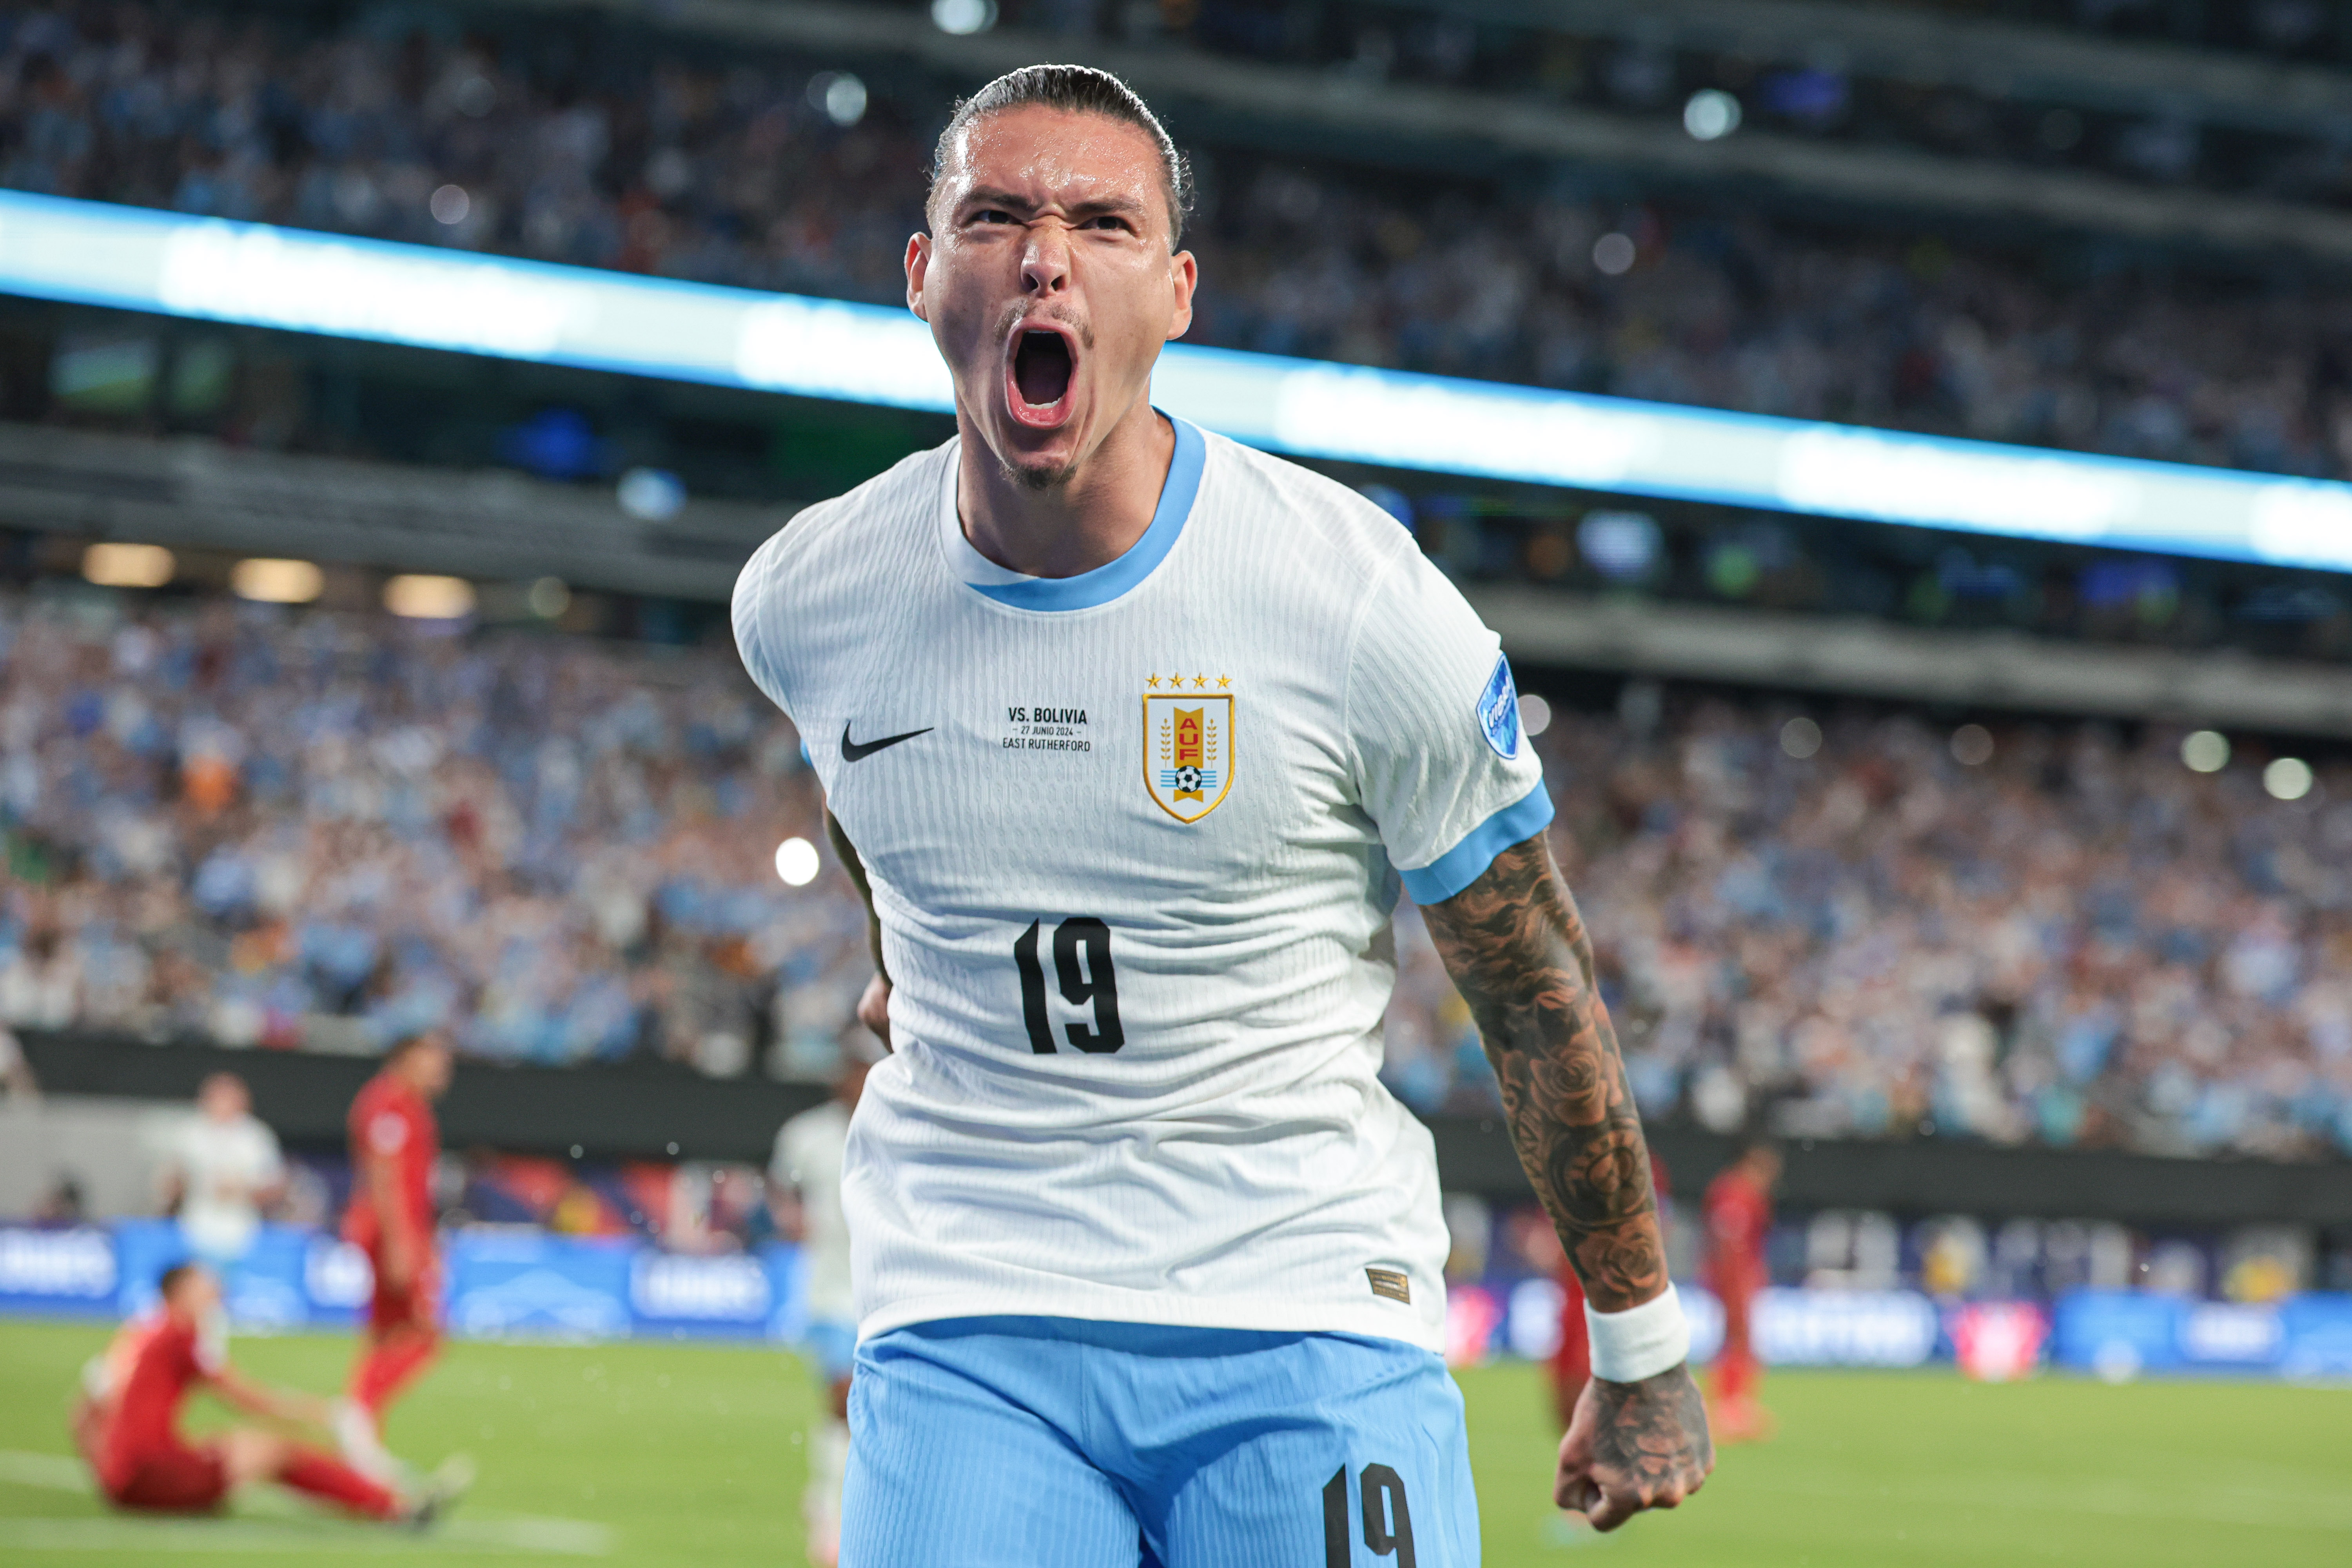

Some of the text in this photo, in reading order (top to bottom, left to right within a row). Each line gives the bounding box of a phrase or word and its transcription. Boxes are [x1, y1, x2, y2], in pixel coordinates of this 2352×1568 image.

[1008, 707, 1087, 724] VS. BOLIVIA
[1003, 737, 1091, 751] EAST RUTHERFORD
[1021, 726, 1073, 736] 27 JUNIO 2024
[1179, 718, 1198, 761] AUF
[1014, 917, 1125, 1054] 19
[1322, 1462, 1416, 1568] 19
